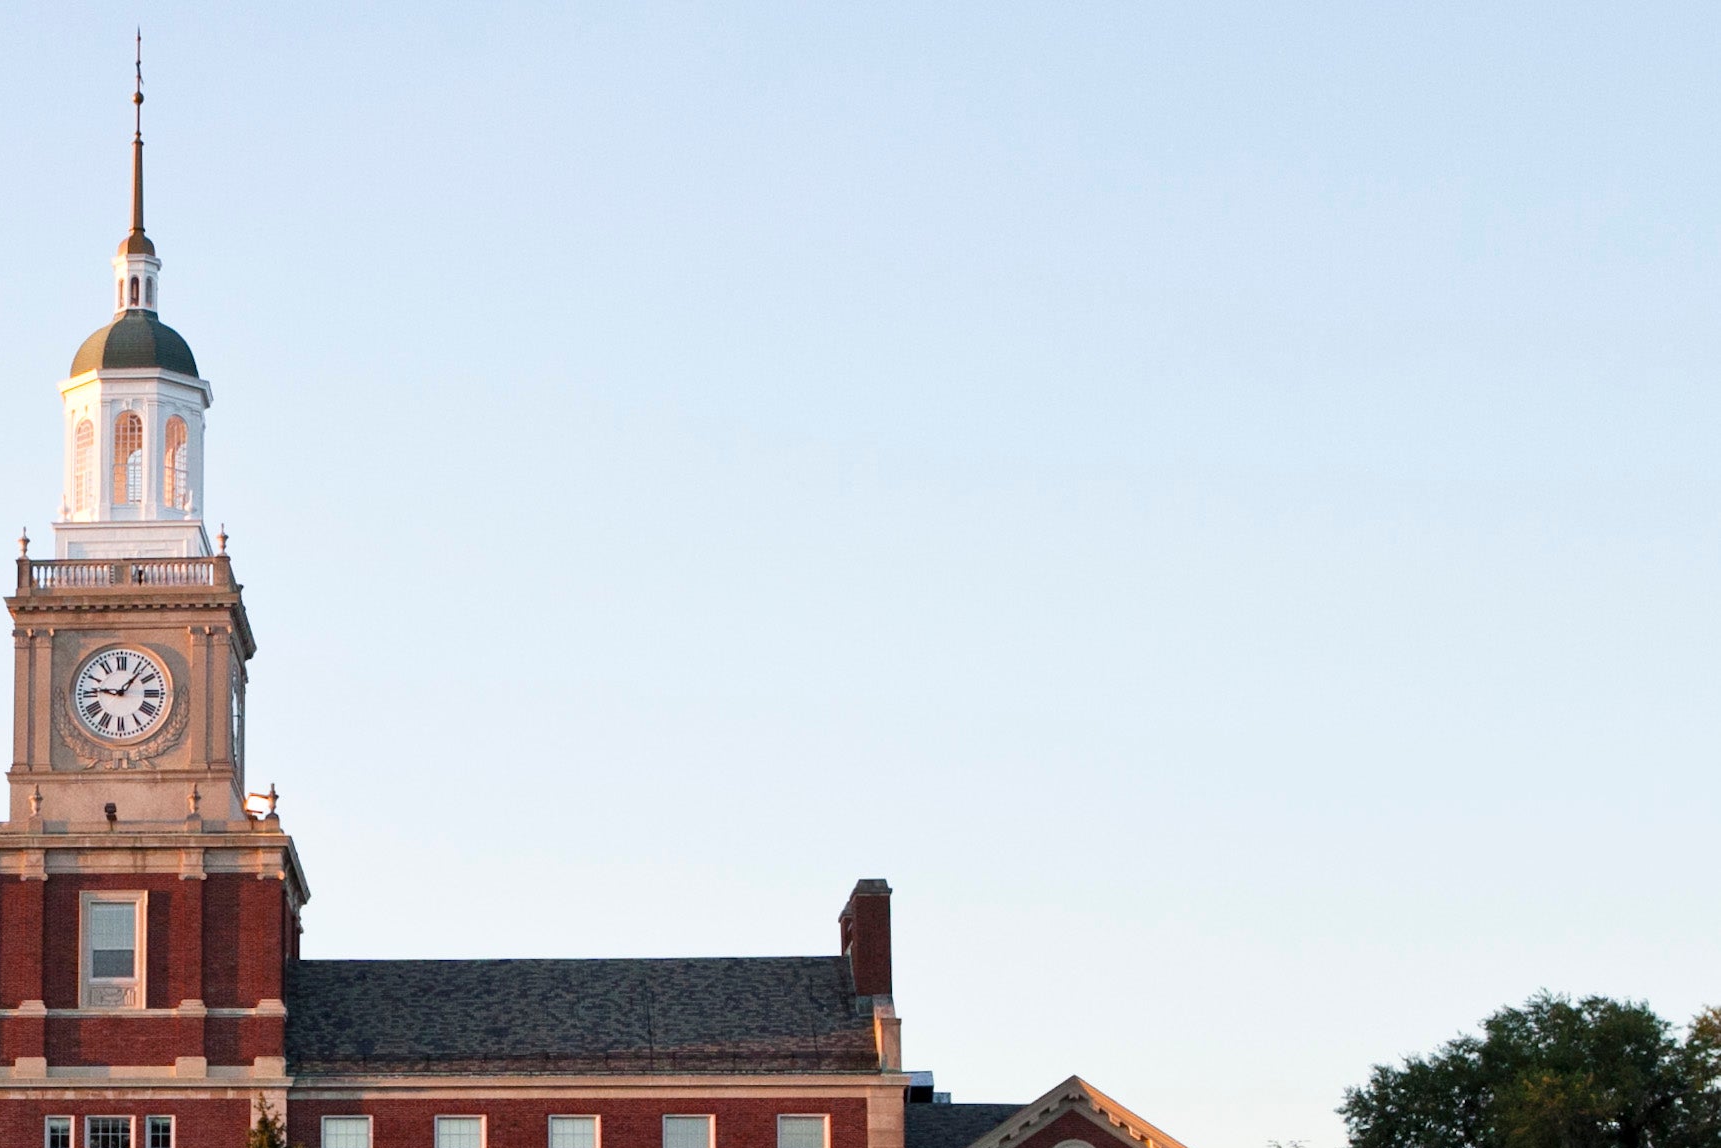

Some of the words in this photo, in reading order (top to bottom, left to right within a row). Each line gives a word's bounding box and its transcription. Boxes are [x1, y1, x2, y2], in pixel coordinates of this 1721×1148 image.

[99, 660, 112, 674] XI
[117, 657, 127, 671] XII
[141, 673, 155, 684] II
[144, 689, 159, 698] III
[85, 700, 103, 718] VIII
[98, 712, 112, 728] VII
[117, 717, 125, 731] VI
[132, 713, 141, 726] V
